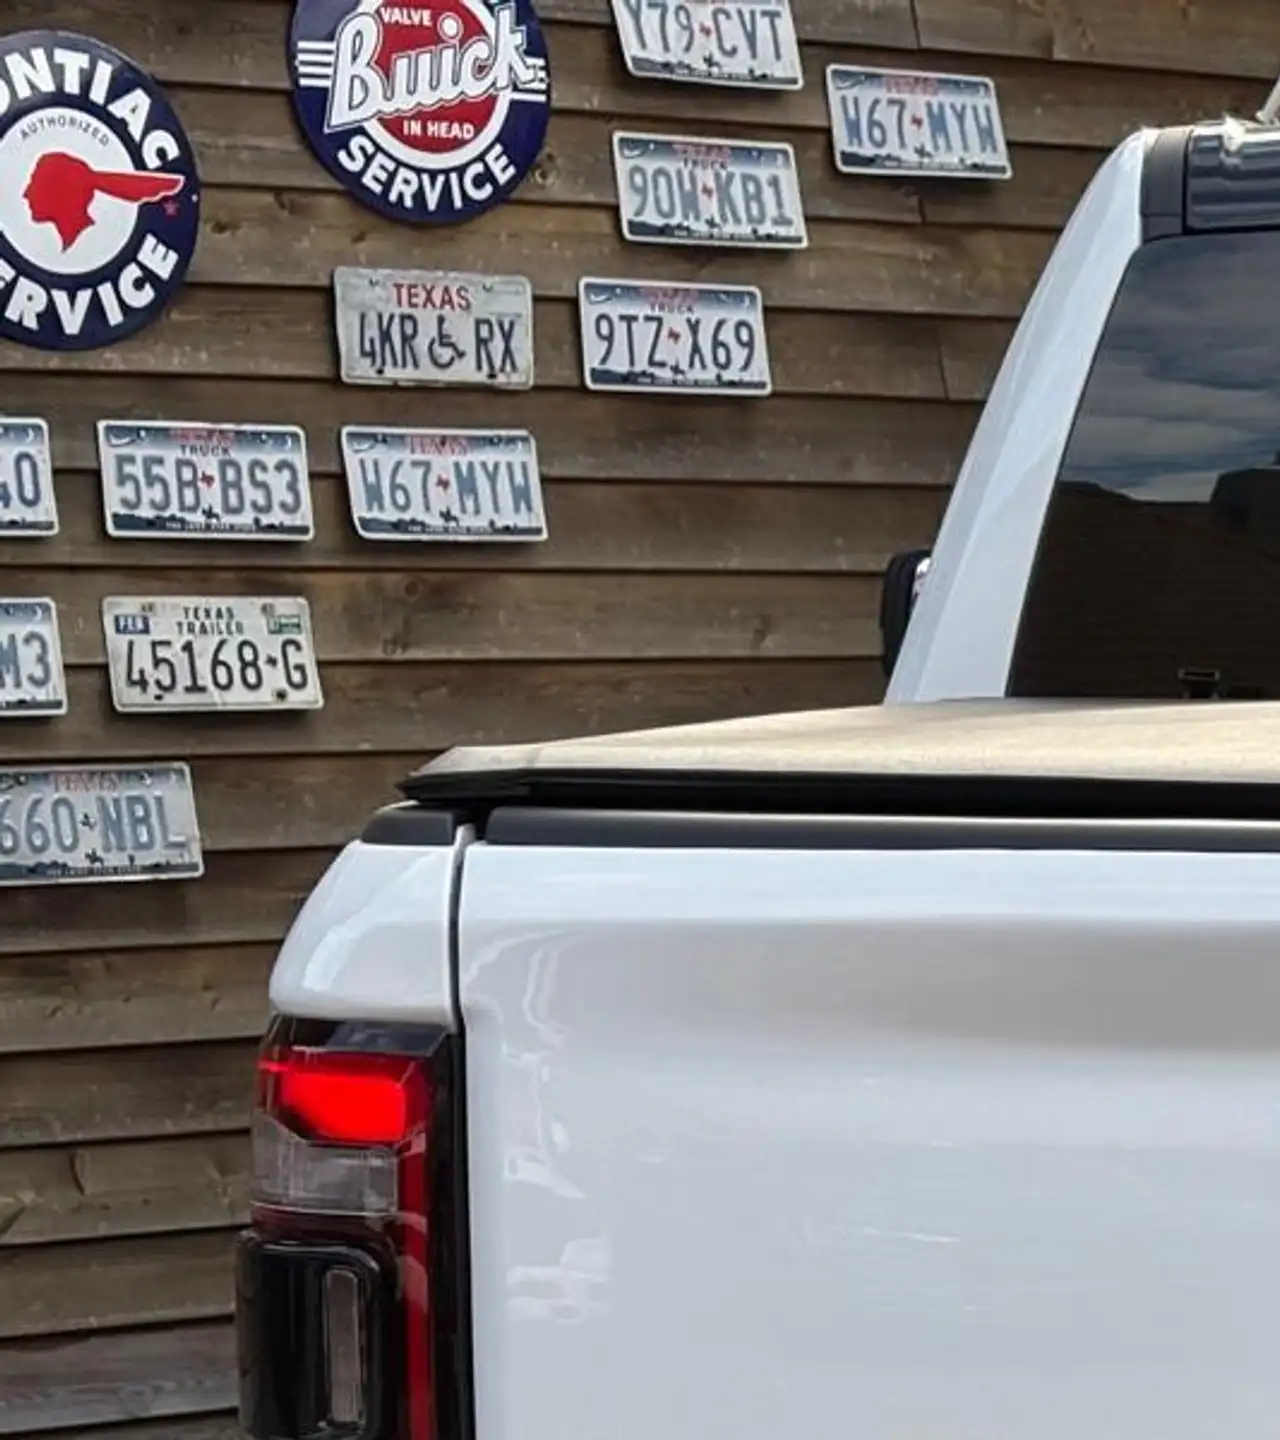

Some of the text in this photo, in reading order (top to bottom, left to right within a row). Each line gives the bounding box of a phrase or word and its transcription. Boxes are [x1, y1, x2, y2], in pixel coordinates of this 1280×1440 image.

[380, 6, 433, 26] VALVE
[711, 7, 782, 62] CVT
[324, 3, 527, 133] Buick
[0, 47, 181, 170] NTIAC
[20, 114, 111, 148] AUTHORIZED
[403, 119, 475, 139] IN HEAD
[337, 134, 517, 213] SERVICE
[714, 171, 794, 226] KB1
[0, 234, 180, 335] RVICE
[392, 282, 472, 312] TEXAS
[359, 311, 519, 374] 4KR RX
[594, 313, 756, 372] 9TZ X69
[114, 453, 301, 515] 55B BS3
[358, 458, 533, 515] W67 MYW
[176, 620, 245, 636] TRAILER
[182, 606, 236, 621] TEXAS
[126, 637, 309, 694] 45168 G
[96, 794, 188, 854] NBL
